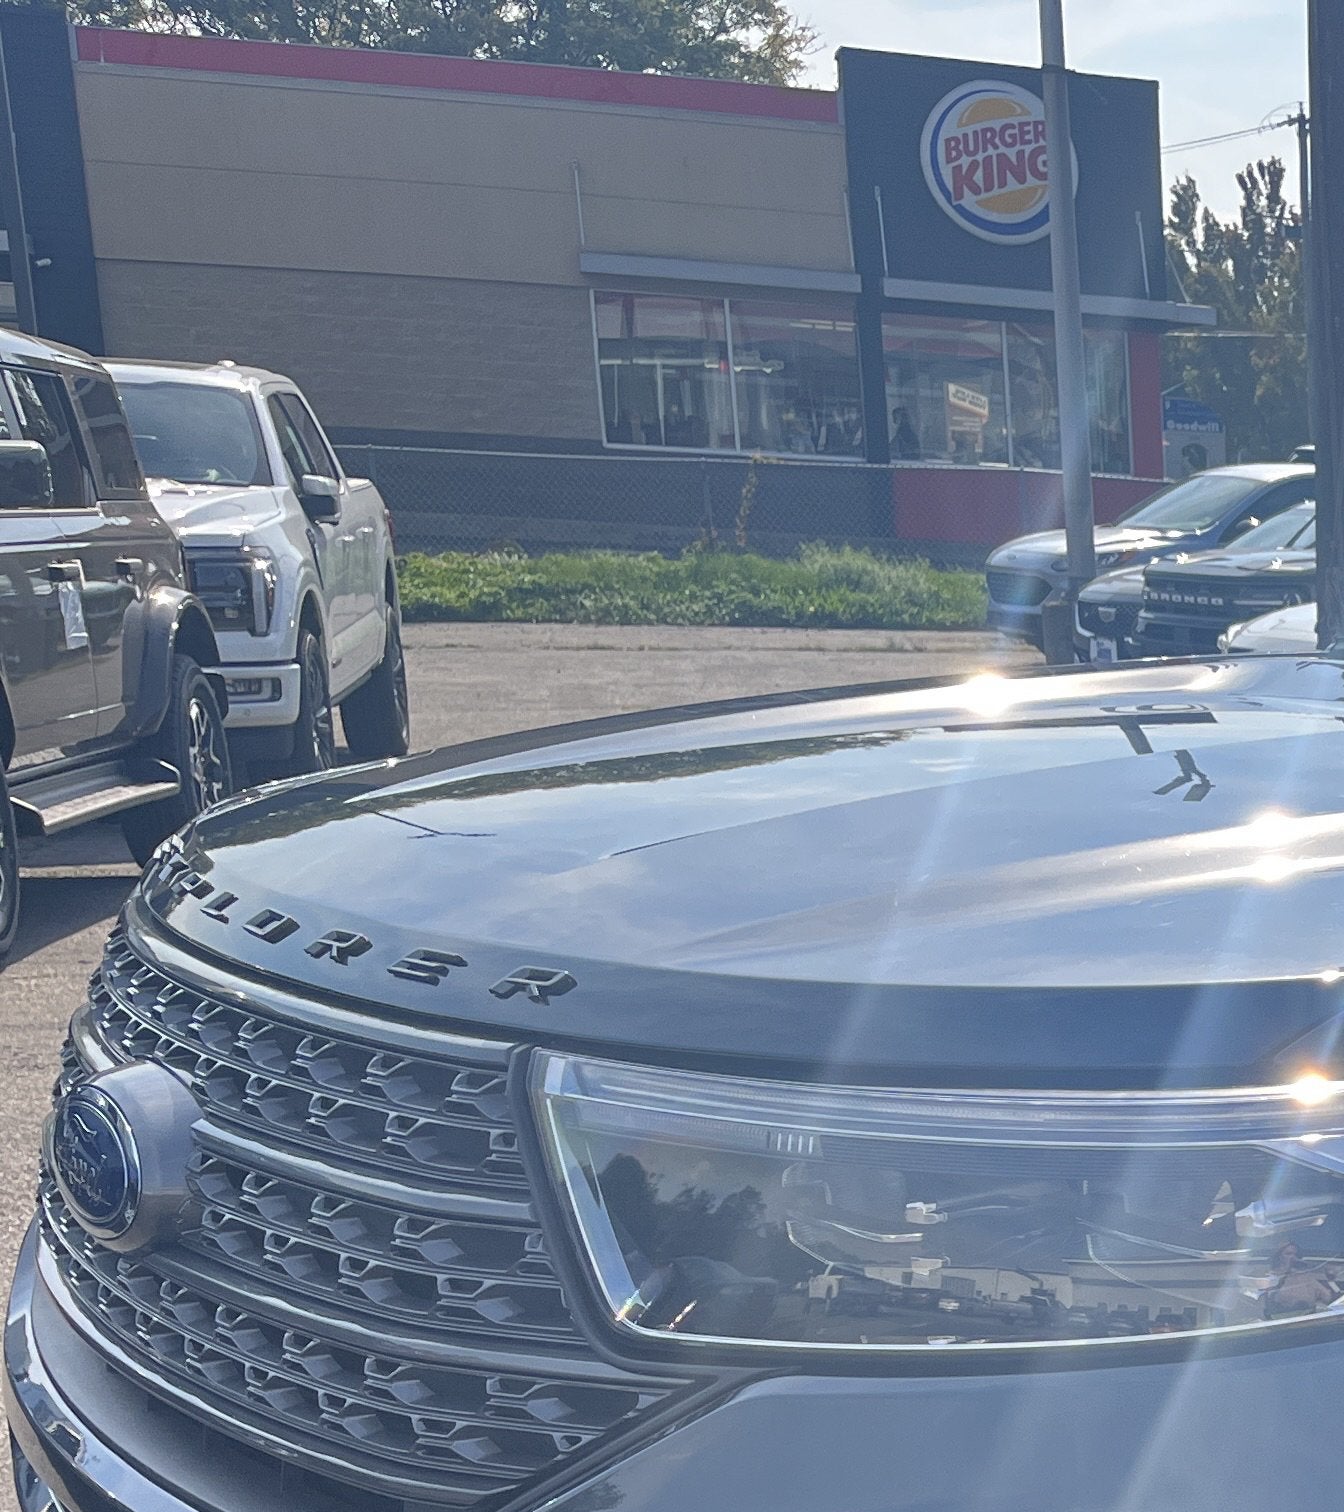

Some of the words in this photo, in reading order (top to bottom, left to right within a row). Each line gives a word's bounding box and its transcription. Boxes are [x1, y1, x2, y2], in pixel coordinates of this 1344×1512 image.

[944, 120, 1046, 164] BURGER
[952, 145, 1048, 202] KING
[1149, 592, 1224, 606] BRONCO
